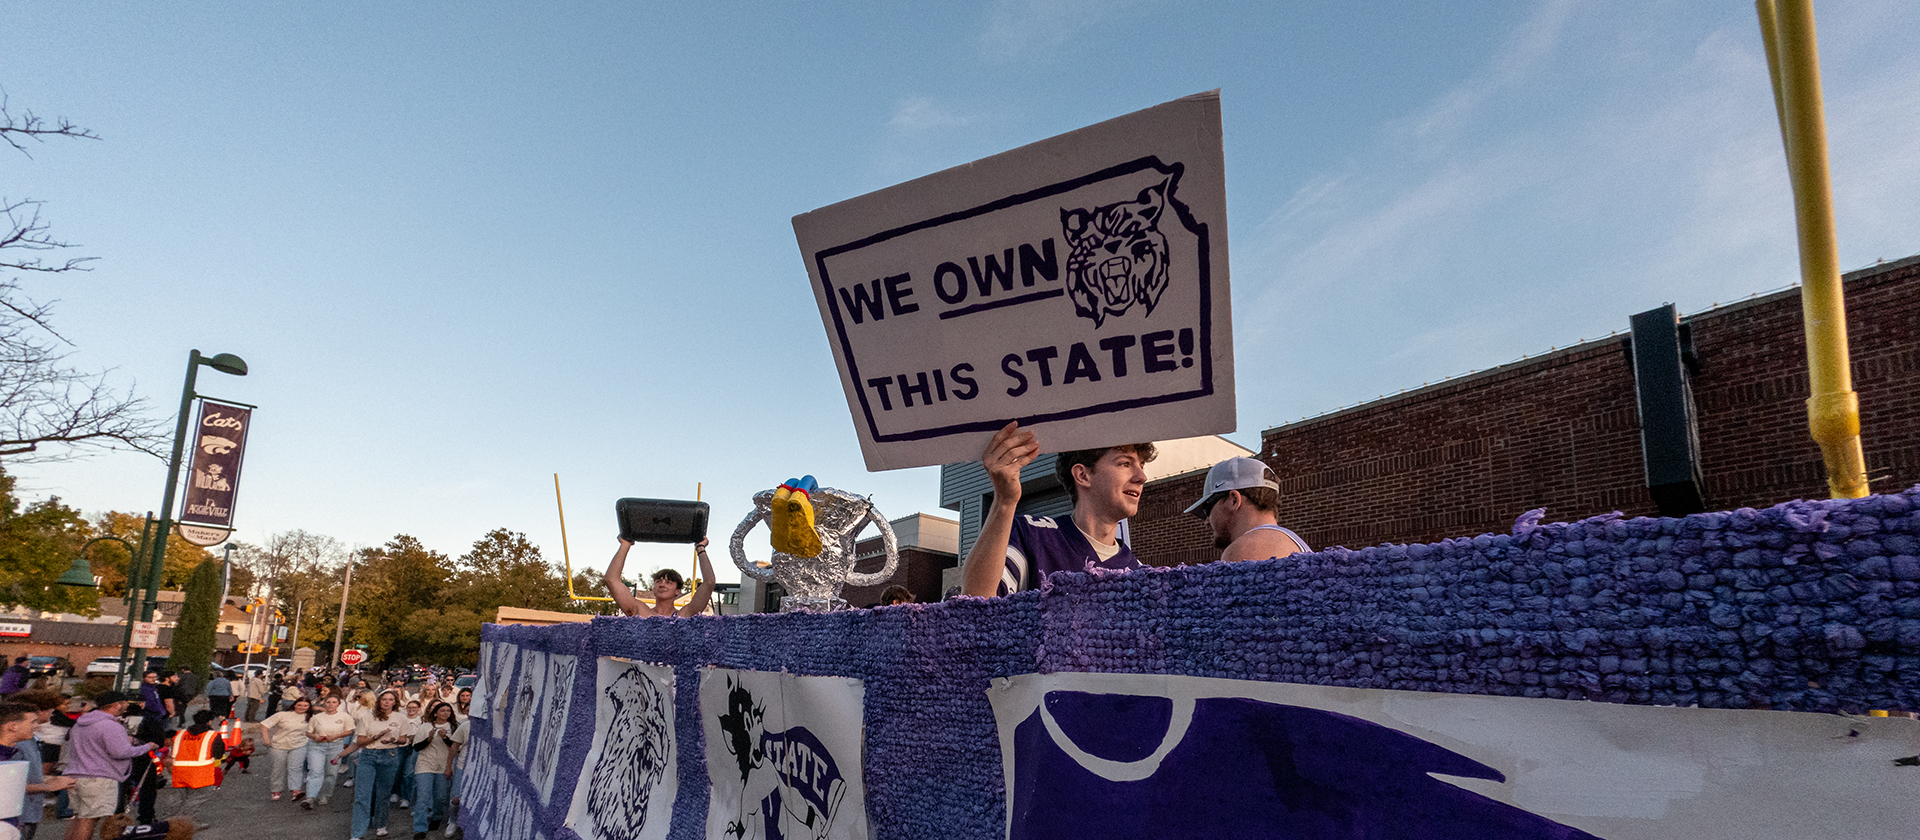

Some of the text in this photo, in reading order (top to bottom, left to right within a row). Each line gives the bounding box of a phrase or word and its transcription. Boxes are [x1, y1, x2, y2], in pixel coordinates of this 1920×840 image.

[839, 237, 1059, 324] WE OWN
[867, 327, 1194, 411] THIS STATE!
[202, 412, 243, 431] Cats
[343, 653, 361, 661] STOP
[765, 739, 828, 801] STATE
